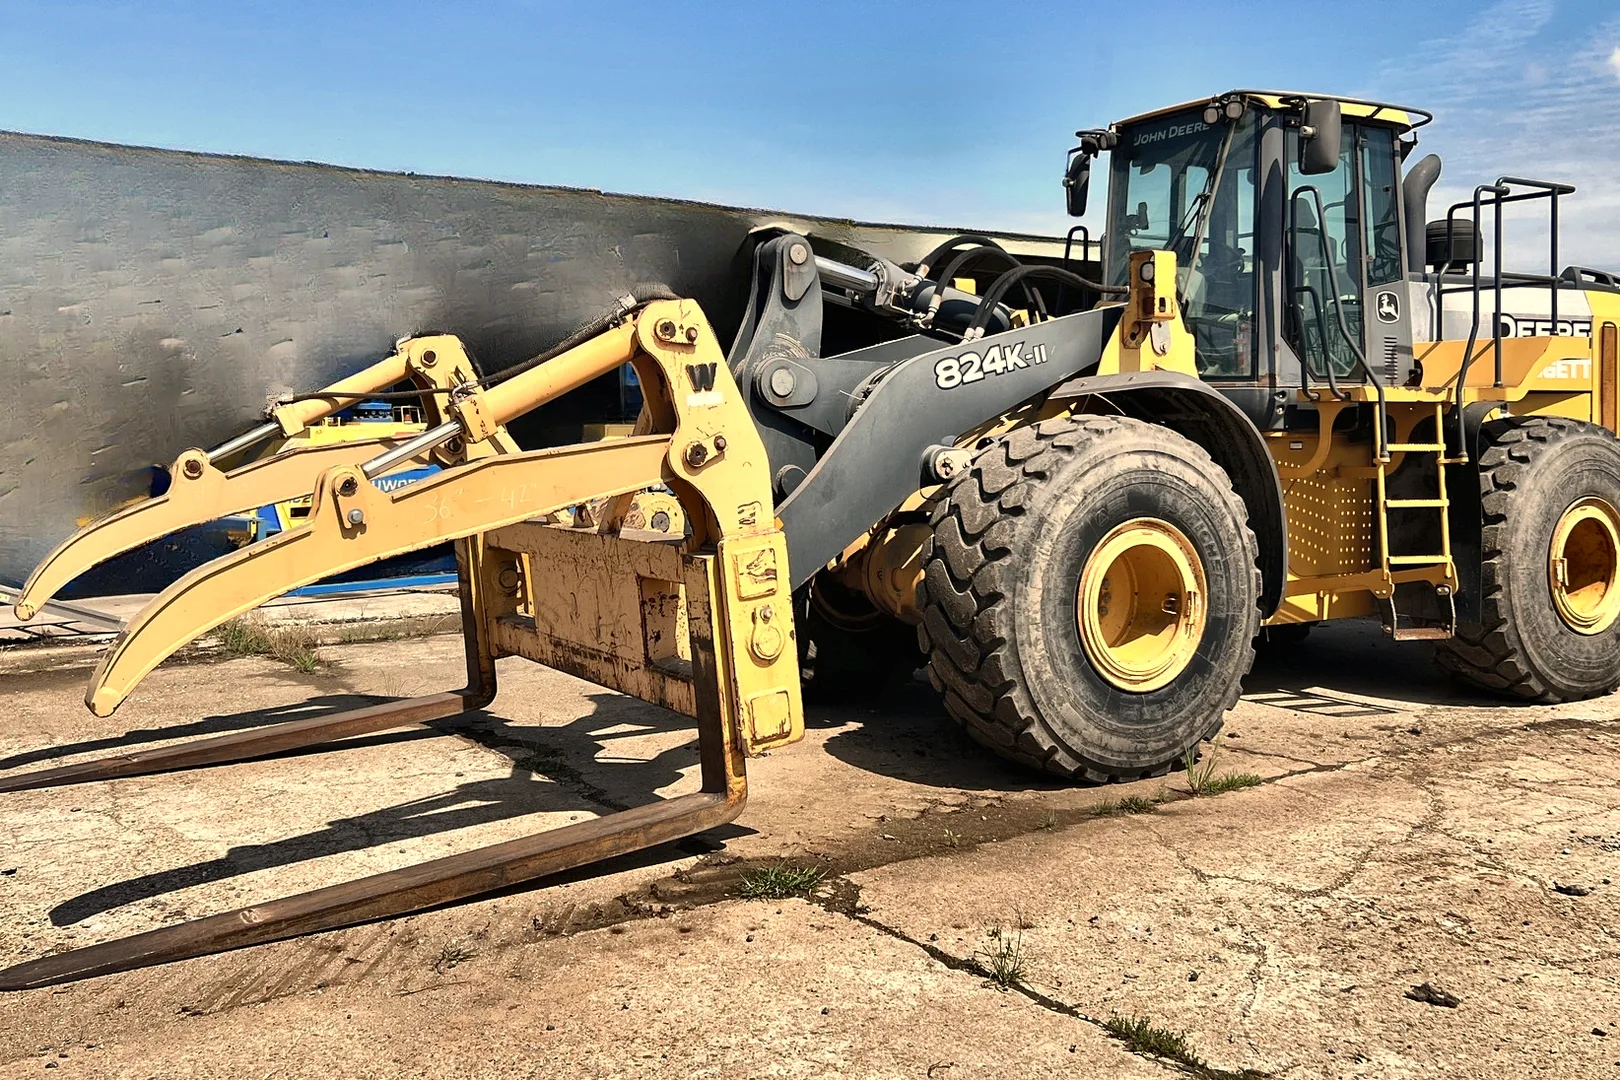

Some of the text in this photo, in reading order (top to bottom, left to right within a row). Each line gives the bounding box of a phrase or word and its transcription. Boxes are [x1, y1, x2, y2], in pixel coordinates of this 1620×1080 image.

[1134, 122, 1211, 147] JOHN DEERE
[685, 362, 717, 393] W
[934, 341, 1047, 390] 824K-II
[1537, 360, 1591, 379] GETT
